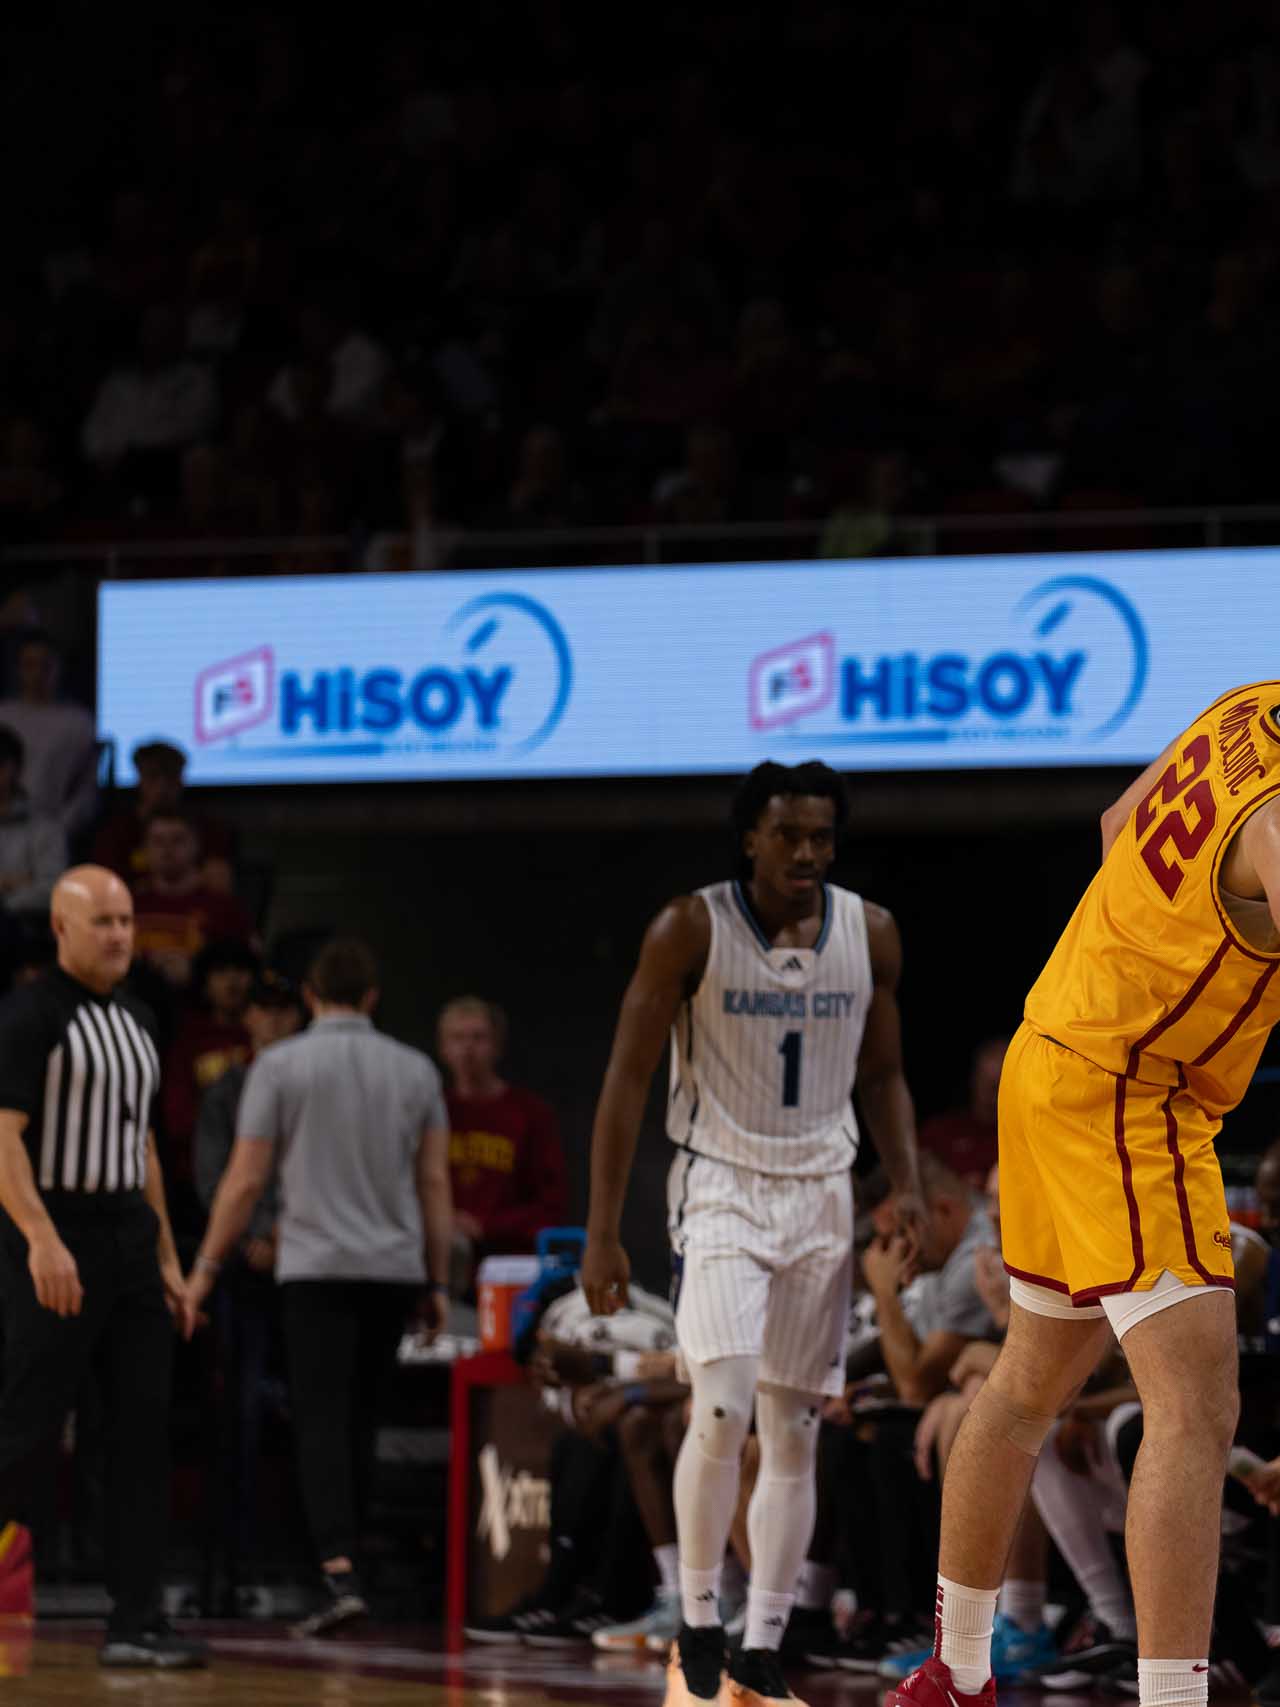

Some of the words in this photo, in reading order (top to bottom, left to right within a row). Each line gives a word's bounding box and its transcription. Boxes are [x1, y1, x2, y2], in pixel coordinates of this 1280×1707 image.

[1135, 734, 1218, 902] 22
[722, 989, 806, 1017] KANSAS
[812, 990, 856, 1018] CITY
[777, 1032, 800, 1107] 1
